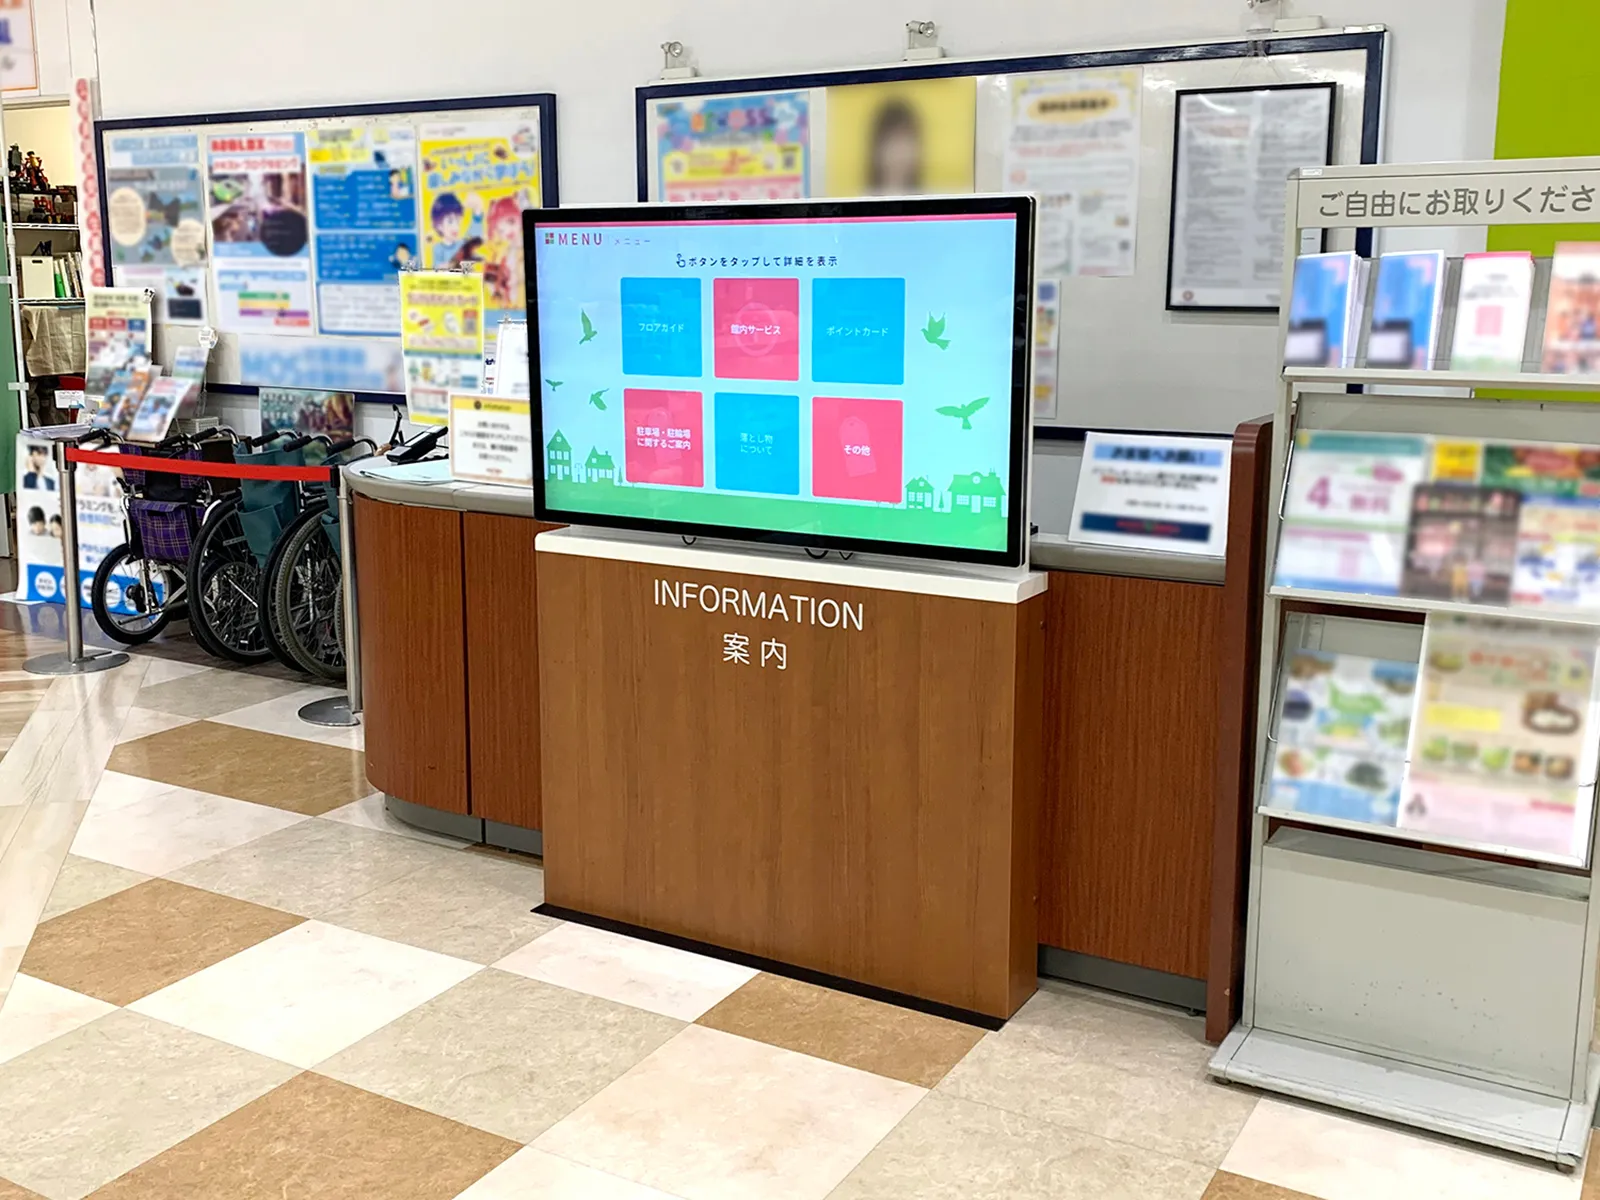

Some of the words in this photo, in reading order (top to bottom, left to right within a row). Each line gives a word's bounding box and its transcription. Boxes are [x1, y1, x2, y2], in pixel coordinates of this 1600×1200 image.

[1319, 184, 1596, 218] ご自由にお取りくださ
[558, 232, 603, 246] MENU
[614, 237, 651, 246] メニュー
[688, 255, 839, 268] ボタンをタップして詳細を表示
[638, 322, 685, 334] フロアガイド
[730, 323, 782, 336] 館内サービス
[826, 325, 889, 338] ポイントカード
[636, 426, 692, 439] 駐車場・駐輪場
[739, 432, 774, 444] 落とし物
[637, 437, 692, 451] に関するご案内
[740, 443, 773, 456] について
[843, 444, 872, 457] その他
[653, 578, 864, 632] INFORMATION
[722, 632, 788, 671] 案内
